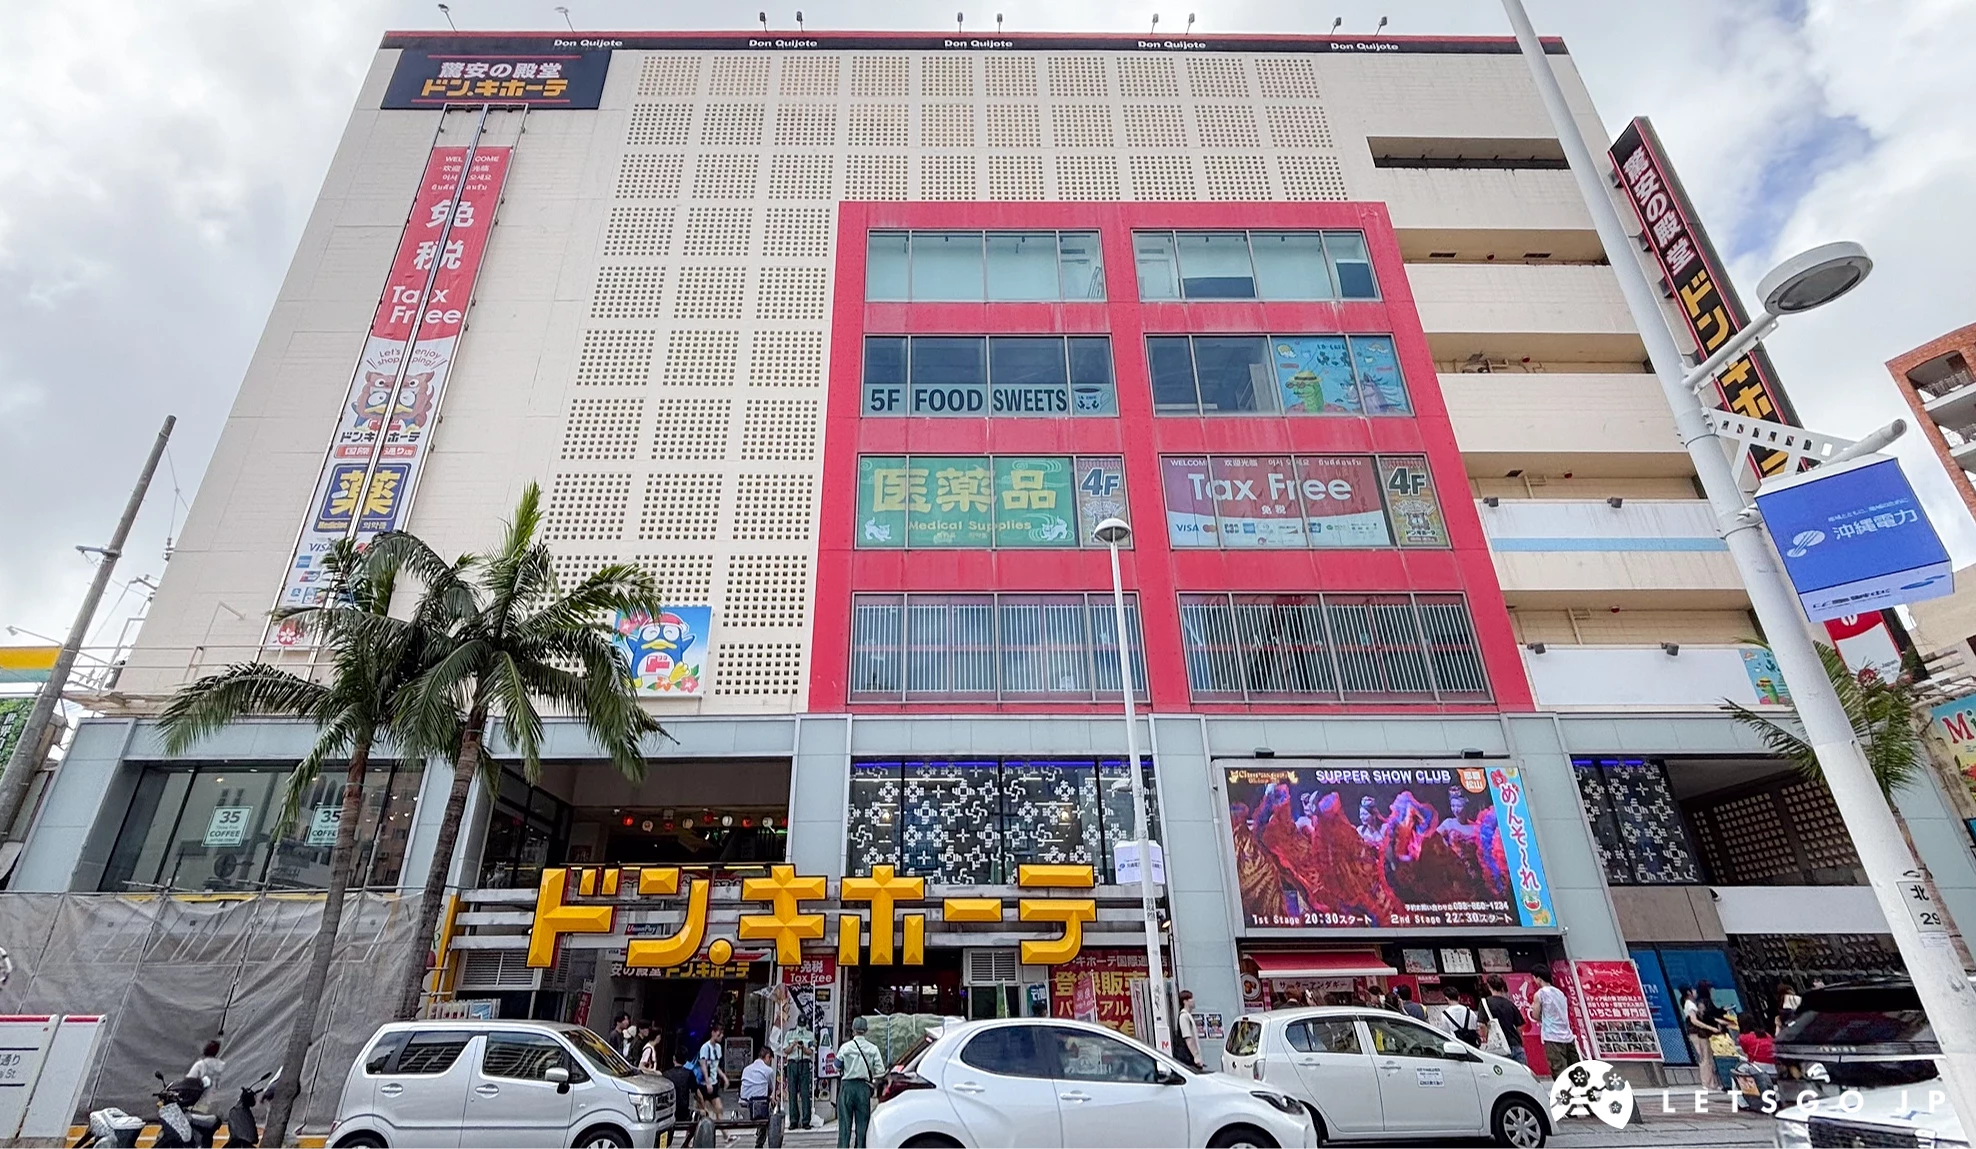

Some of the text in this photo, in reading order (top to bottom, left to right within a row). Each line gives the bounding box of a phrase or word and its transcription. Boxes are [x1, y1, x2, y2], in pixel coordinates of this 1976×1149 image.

[580, 39, 623, 48] Quijote
[775, 39, 818, 48] Quijote
[944, 39, 1013, 48] Don Quijote
[1163, 40, 1206, 49] Quijote
[1356, 42, 1400, 51] Quijote
[439, 61, 562, 79] 驚安の殿堂
[870, 388, 1068, 412] 5F FOOD SWEETS
[1170, 459, 1209, 467] WELCOM
[1080, 467, 1121, 498] 4F
[1187, 473, 1352, 501] Tax Free
[1387, 466, 1427, 496] 4F
[329, 469, 401, 516] 薬
[872, 467, 1057, 514] 医薬品
[908, 520, 1032, 531] Medical Supplies
[1175, 523, 1200, 533] VISA
[1832, 508, 1919, 541] 沖縄電力
[1315, 769, 1452, 784] SUPPER SHOW CLUB
[219, 810, 242, 823] 35
[320, 810, 342, 823] 35
[311, 829, 337, 837] COFFE
[1910, 884, 1930, 901] 北
[1252, 912, 1373, 926] 1st Stage 20:30スタート
[1390, 913, 1411, 925] 2nd
[1414, 913, 1442, 926] Stage
[1919, 912, 1942, 925] 29
[626, 924, 657, 933] UnionPay
[800, 960, 824, 973] 免税
[790, 973, 833, 983] Tax Free
[1643, 984, 1659, 994] TM
